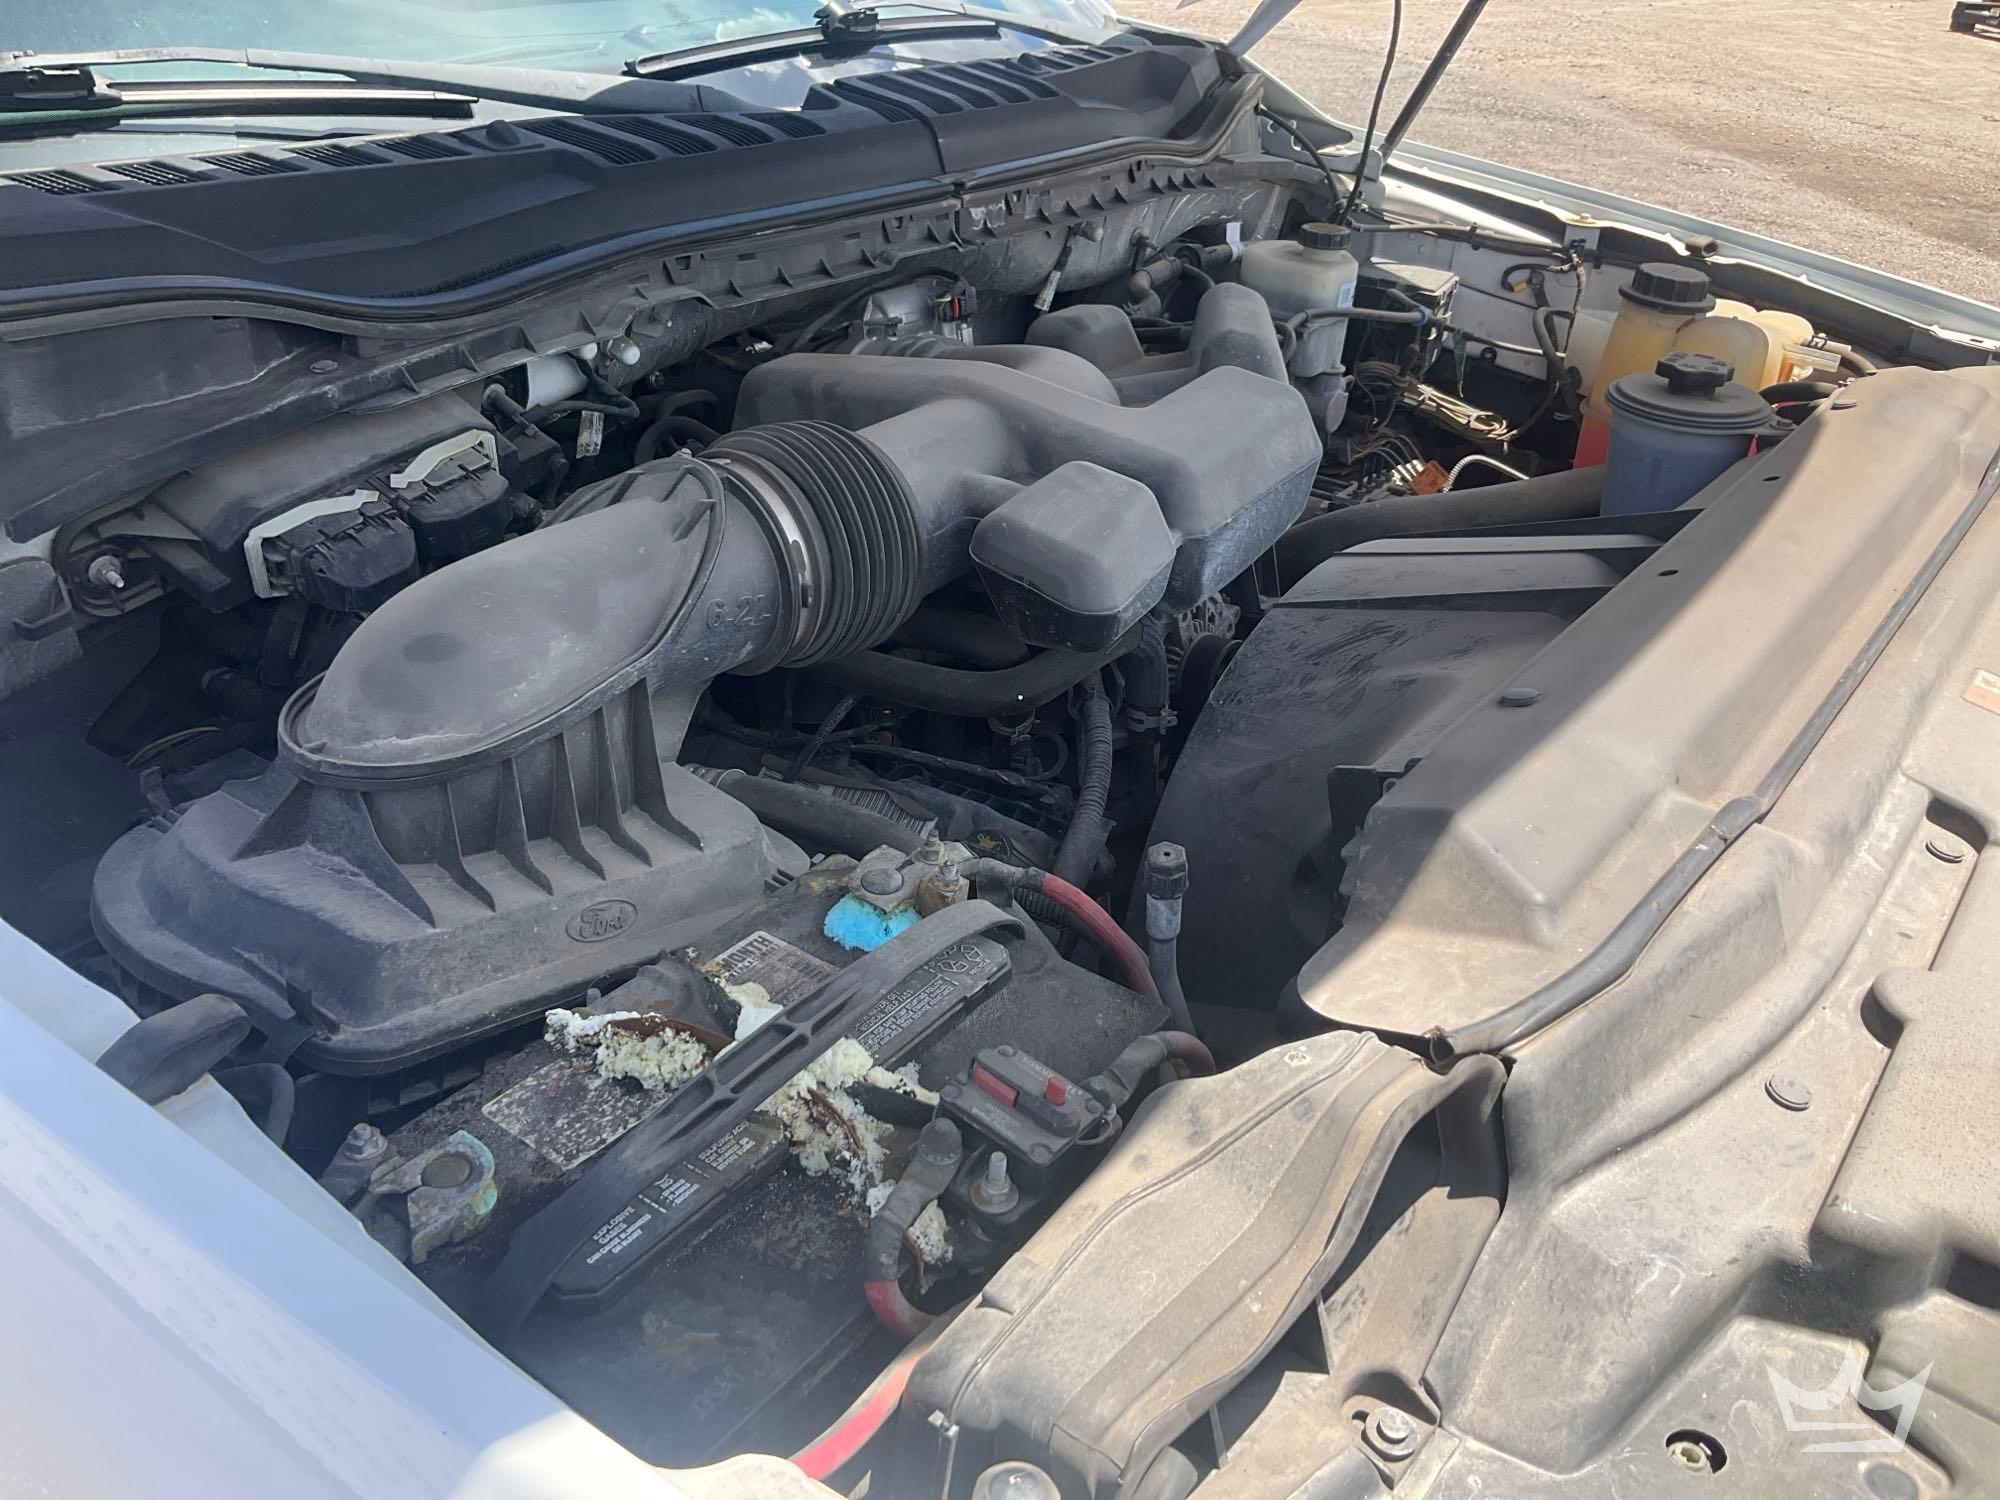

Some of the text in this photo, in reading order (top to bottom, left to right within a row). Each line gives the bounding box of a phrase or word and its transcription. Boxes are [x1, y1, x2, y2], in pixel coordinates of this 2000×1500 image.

[579, 905, 628, 939] Ford
[592, 1205, 636, 1241] EXPLOSIVE
[598, 1222, 628, 1245] GASES
